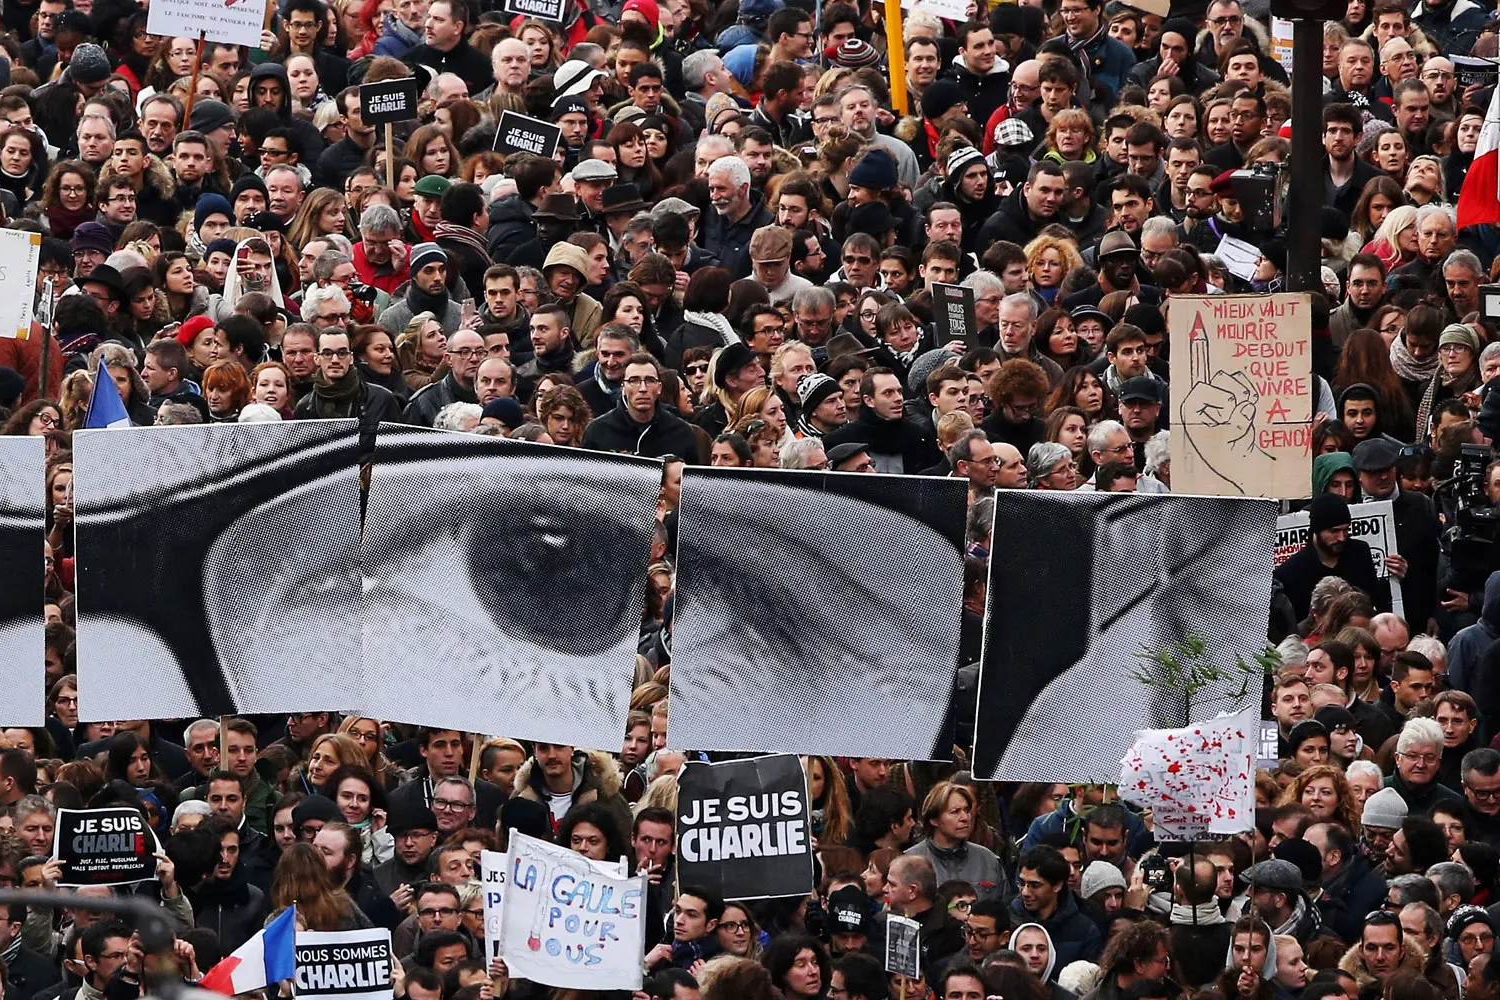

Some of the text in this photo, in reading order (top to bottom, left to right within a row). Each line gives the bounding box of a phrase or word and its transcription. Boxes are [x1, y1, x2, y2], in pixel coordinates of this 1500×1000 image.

[515, 0, 559, 16] CHARLIE
[368, 92, 405, 104] JE SUIS
[369, 100, 406, 114] CHARLIE
[505, 134, 544, 154] CHARLIE
[508, 128, 546, 143] JE SUIS
[947, 302, 964, 314] NOUS
[1258, 301, 1300, 318] VAUT
[949, 318, 966, 331] TOUS
[1232, 341, 1307, 360] DEBOUT
[1250, 361, 1290, 377] QUE
[1261, 728, 1279, 741] IS
[680, 790, 803, 825] JE SUIS
[73, 816, 142, 834] JE SUIS
[72, 831, 145, 856] CHARLIE
[681, 820, 806, 862] CHARLIE
[513, 857, 540, 891] LA
[551, 873, 642, 920] GAULE
[549, 905, 619, 943] POUR
[295, 944, 389, 963] NOUS SOMMES
[296, 959, 391, 991] CHARLIE
